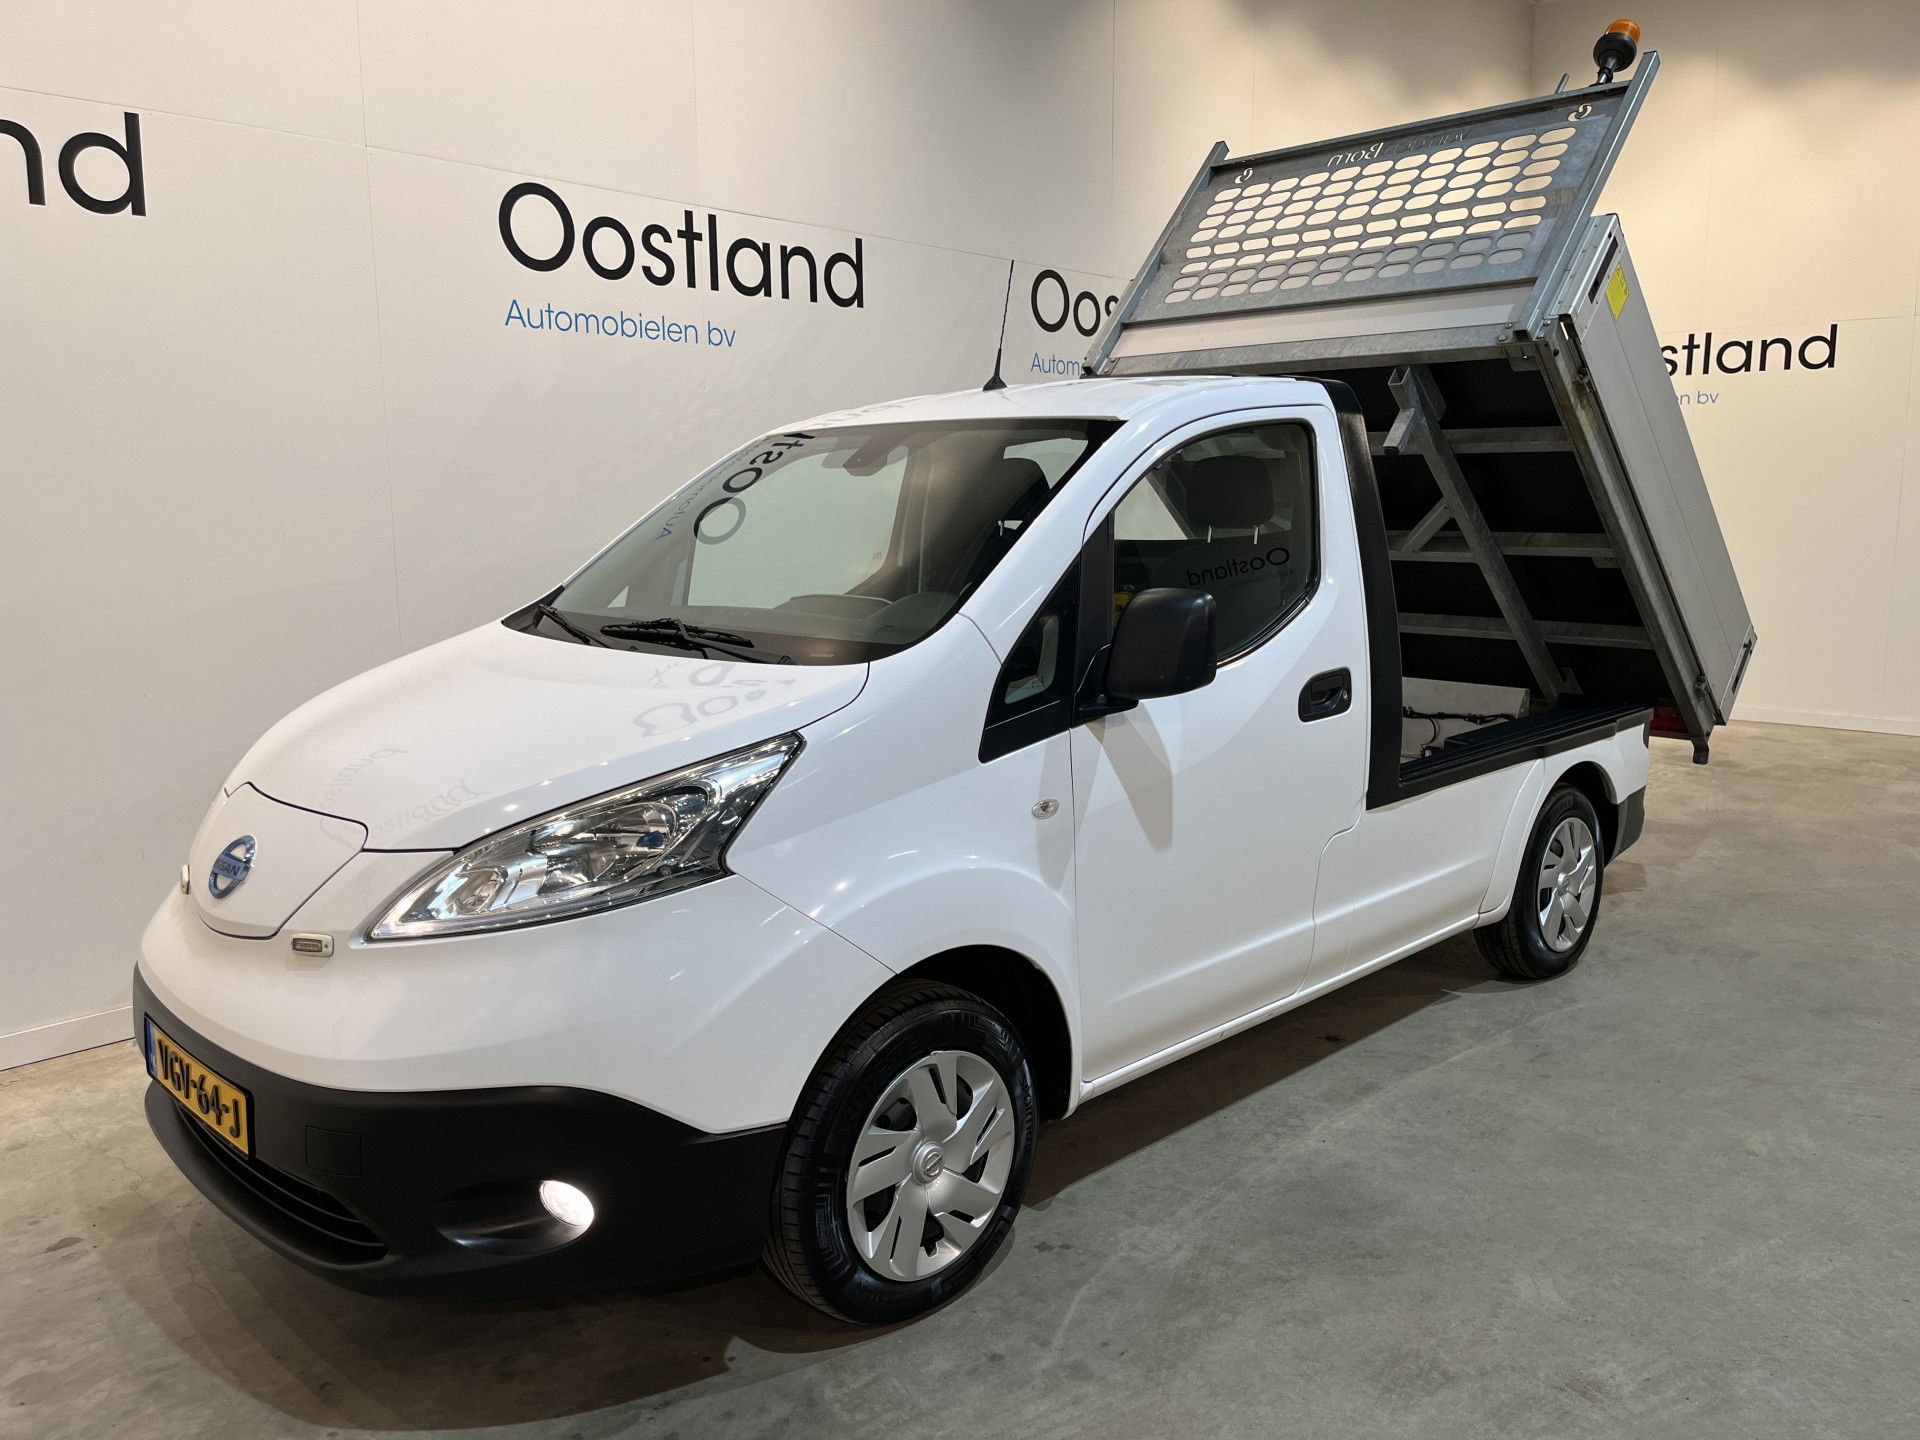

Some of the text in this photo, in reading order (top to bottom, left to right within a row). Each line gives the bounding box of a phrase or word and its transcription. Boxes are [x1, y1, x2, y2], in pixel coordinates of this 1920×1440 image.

[498, 182, 864, 308] Oostland
[505, 299, 736, 348] Automobielen bv
[1030, 352, 1084, 376] Autom
[1697, 390, 1719, 405] bv
[158, 1038, 241, 1139] VGV-64-J
